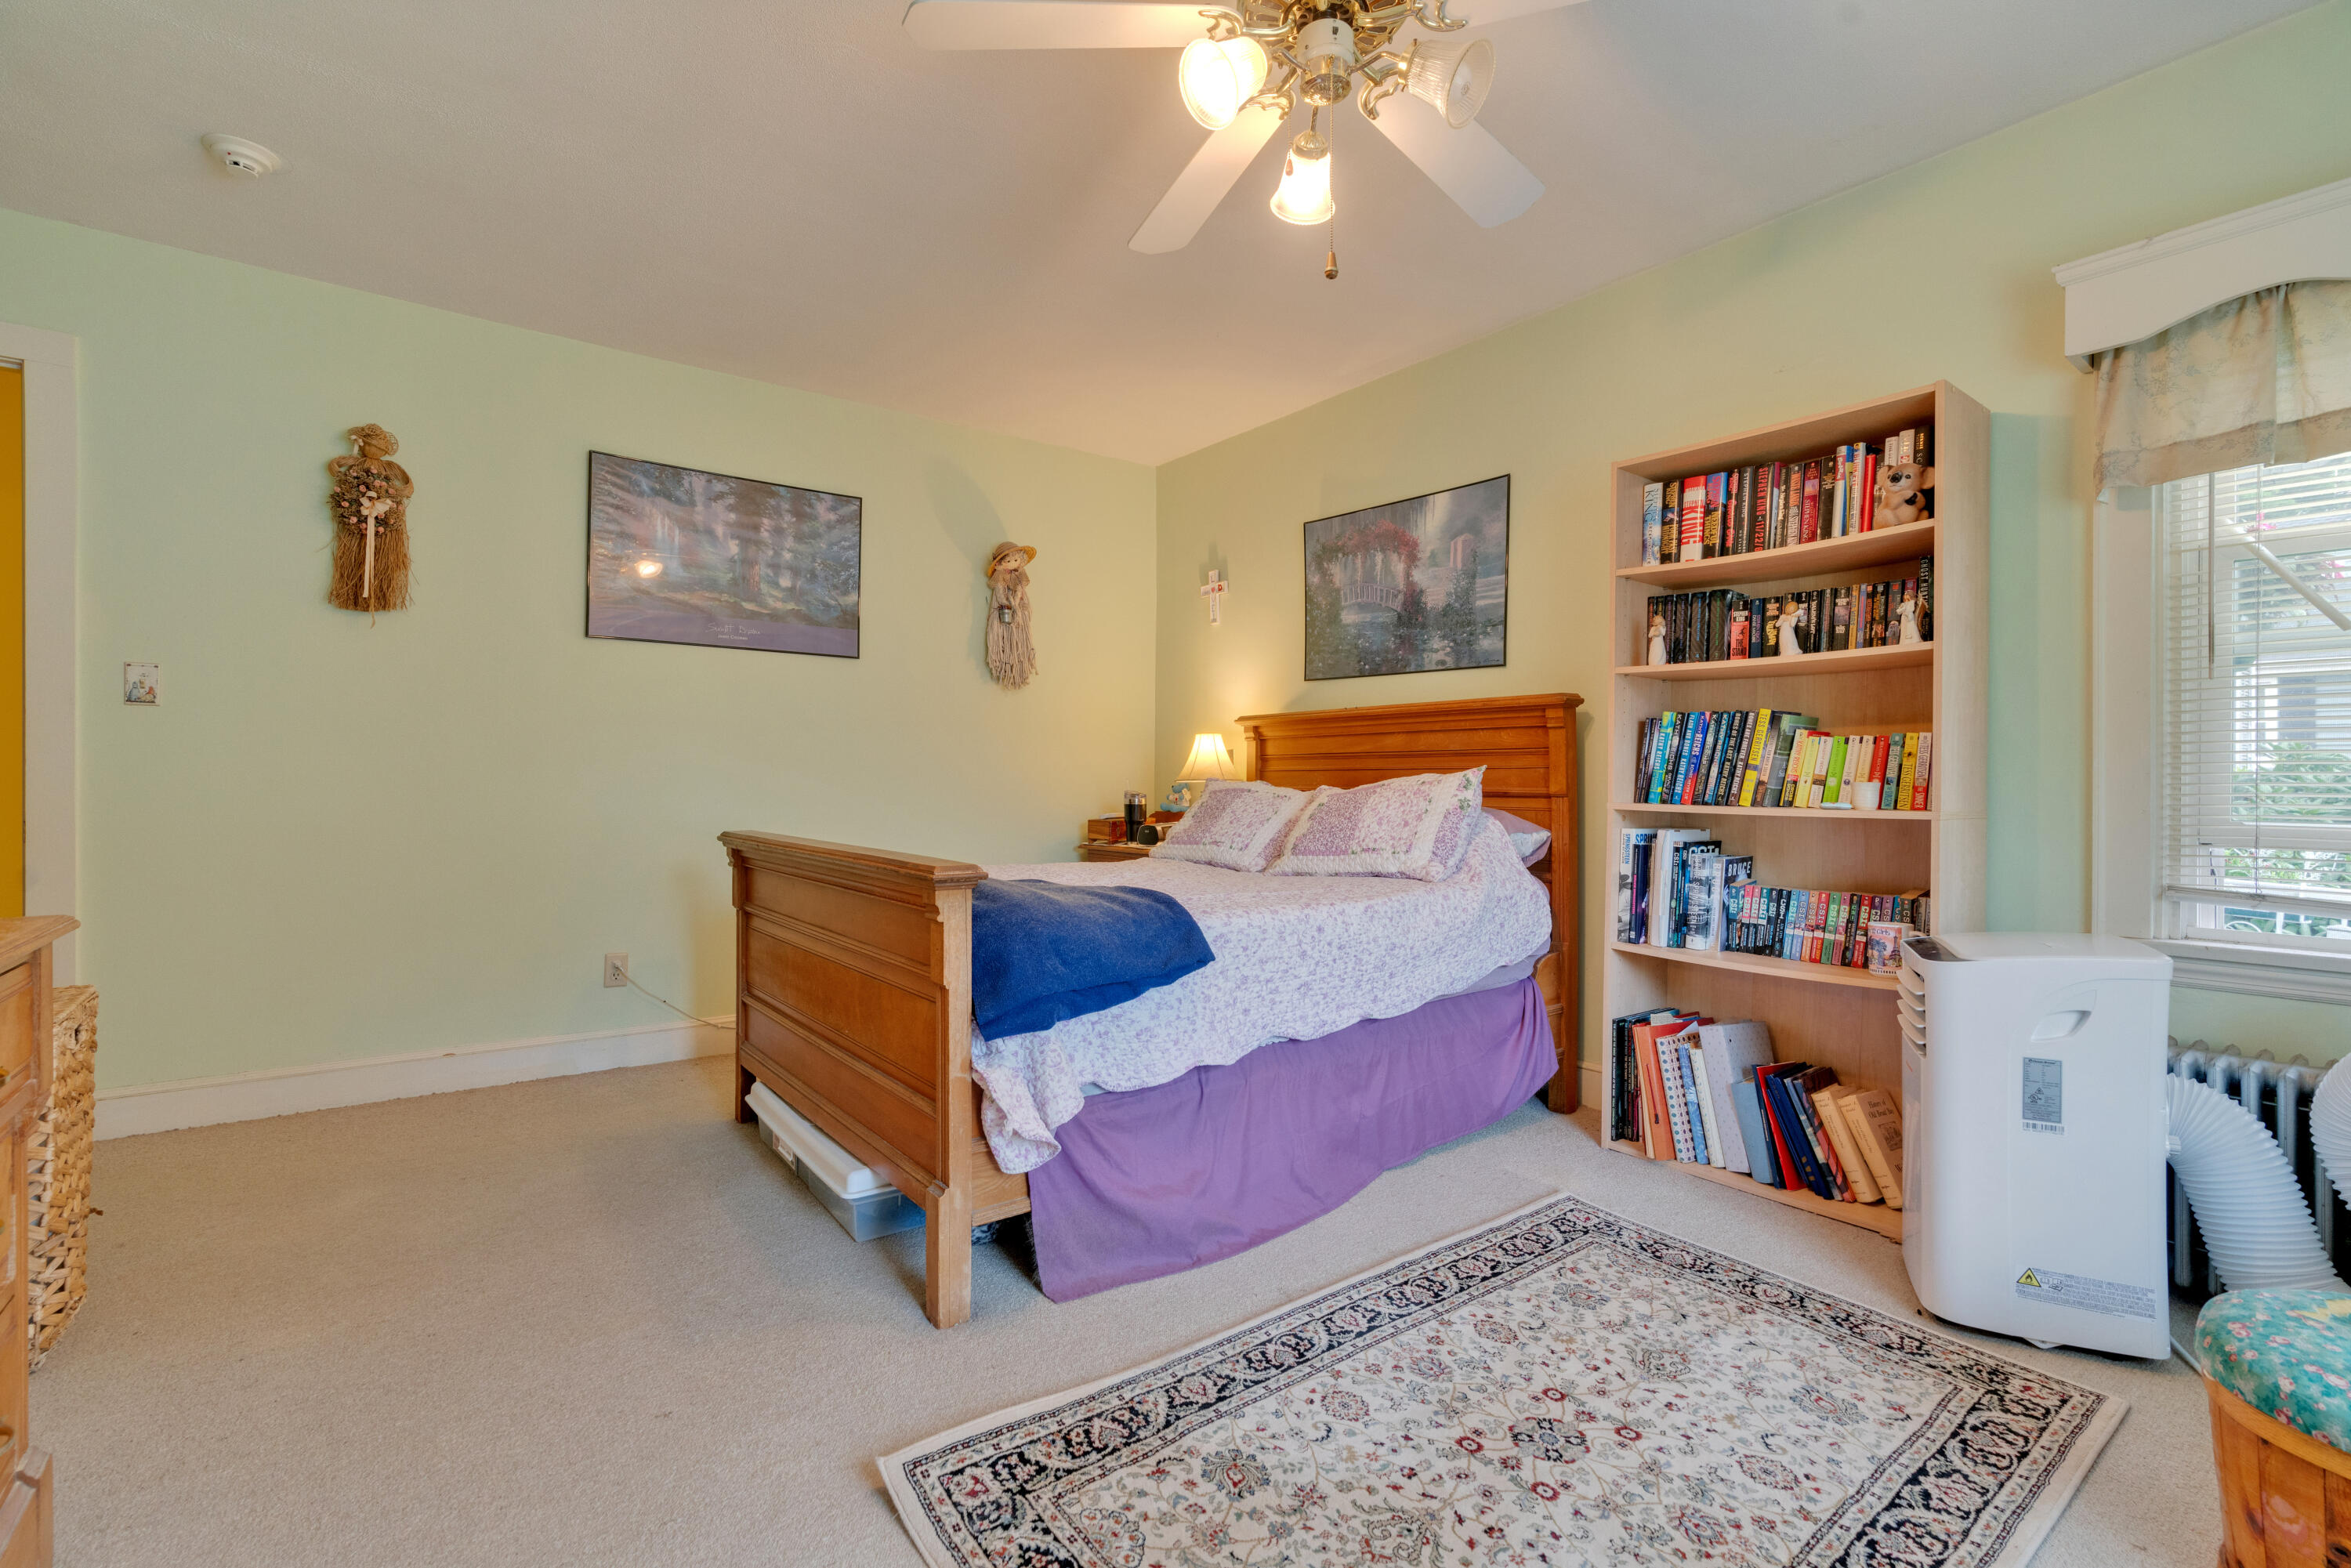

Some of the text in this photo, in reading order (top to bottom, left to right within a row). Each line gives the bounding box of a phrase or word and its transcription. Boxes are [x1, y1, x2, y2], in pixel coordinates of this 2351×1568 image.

[1758, 467, 1768, 497] STEPHEN
[1710, 476, 1721, 508] STEPHEN
[1645, 490, 1654, 523] KING
[1756, 498, 1767, 516] KING
[1681, 505, 1704, 545] KING
[1710, 511, 1719, 545] NEEDFUL
[1661, 525, 1670, 554] MIDNIGHT
[1920, 559, 1929, 580] GHOST
[1731, 647, 1747, 657] STAND
[1719, 714, 1728, 740] KATHY
[1733, 713, 1741, 729] BONES
[1746, 712, 1755, 727] BONES
[1691, 733, 1703, 756] REICHS
[1750, 714, 1768, 762] TESS GERRITSEN
[1654, 733, 1665, 770] KATHY REICHS
[1726, 747, 1734, 759] LOST
[1739, 738, 1749, 759] FOREVER
[1795, 741, 1803, 756] KATHY
[1889, 745, 1900, 755] TESS
[1919, 745, 1929, 755] TESS
[1678, 759, 1687, 775] KATHY
[1722, 761, 1731, 777] KATHY
[1735, 761, 1744, 777] KATHY
[1886, 755, 1900, 777] GERRITSEN
[1918, 755, 1929, 778] GERRITSEN
[1674, 776, 1684, 794] REICHS
[1718, 777, 1727, 795] REICHS
[1731, 777, 1741, 795] REICHS
[1899, 764, 1913, 809] TESS GERRITSEN
[1884, 790, 1893, 808] SURGEON
[1914, 792, 1925, 809] SINNER
[1728, 861, 1752, 877] BRUCE
[1691, 882, 1700, 924] SPRINGSTEEN
[1769, 902, 1777, 918] CSI:
[1788, 900, 1797, 921] CSI:
[1817, 904, 1826, 924] CSI:
[1829, 904, 1838, 926] CSI:
[1840, 905, 1849, 927] CSI:
[1859, 906, 1868, 927] CSI:
[1871, 909, 1881, 922] CS
[1867, 1099, 1882, 1109] History
[1868, 1110, 1878, 1119] Old
